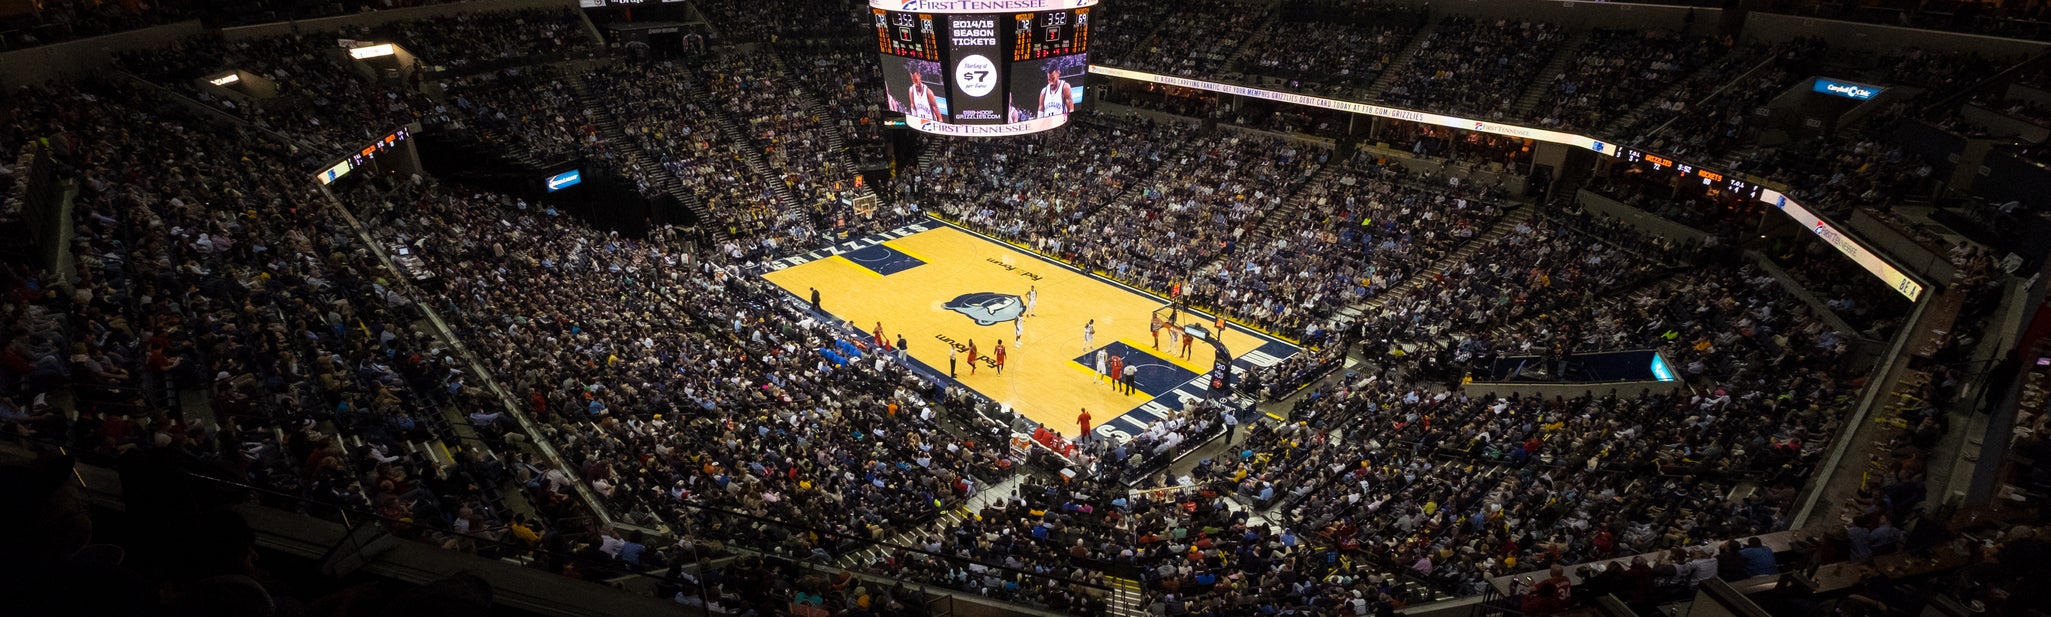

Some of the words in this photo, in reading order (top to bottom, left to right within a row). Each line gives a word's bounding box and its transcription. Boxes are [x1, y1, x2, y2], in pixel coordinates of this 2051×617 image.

[920, 0, 954, 9] FIRST
[955, 0, 1047, 9] TENNESSEE
[953, 20, 994, 28] 2014/15
[1021, 20, 1030, 29] 72
[1078, 14, 1087, 24] 69
[964, 71, 989, 82] $7
[1178, 79, 1200, 87] CARRYING
[1247, 88, 1270, 98] MEMPHIS
[1271, 92, 1298, 102] GRIZZLIES
[1299, 96, 1315, 105] DEBIT
[1316, 98, 1331, 107] CARD
[1333, 101, 1351, 110] TODAY
[1353, 104, 1360, 112] AT
[933, 122, 960, 133] FIRST
[961, 123, 1031, 133] TENNESSEE
[1645, 154, 1673, 167] GRIZZLIES
[1698, 169, 1723, 182] ROCKETS
[1900, 278, 1910, 293] BE
[1909, 286, 1916, 297] A
